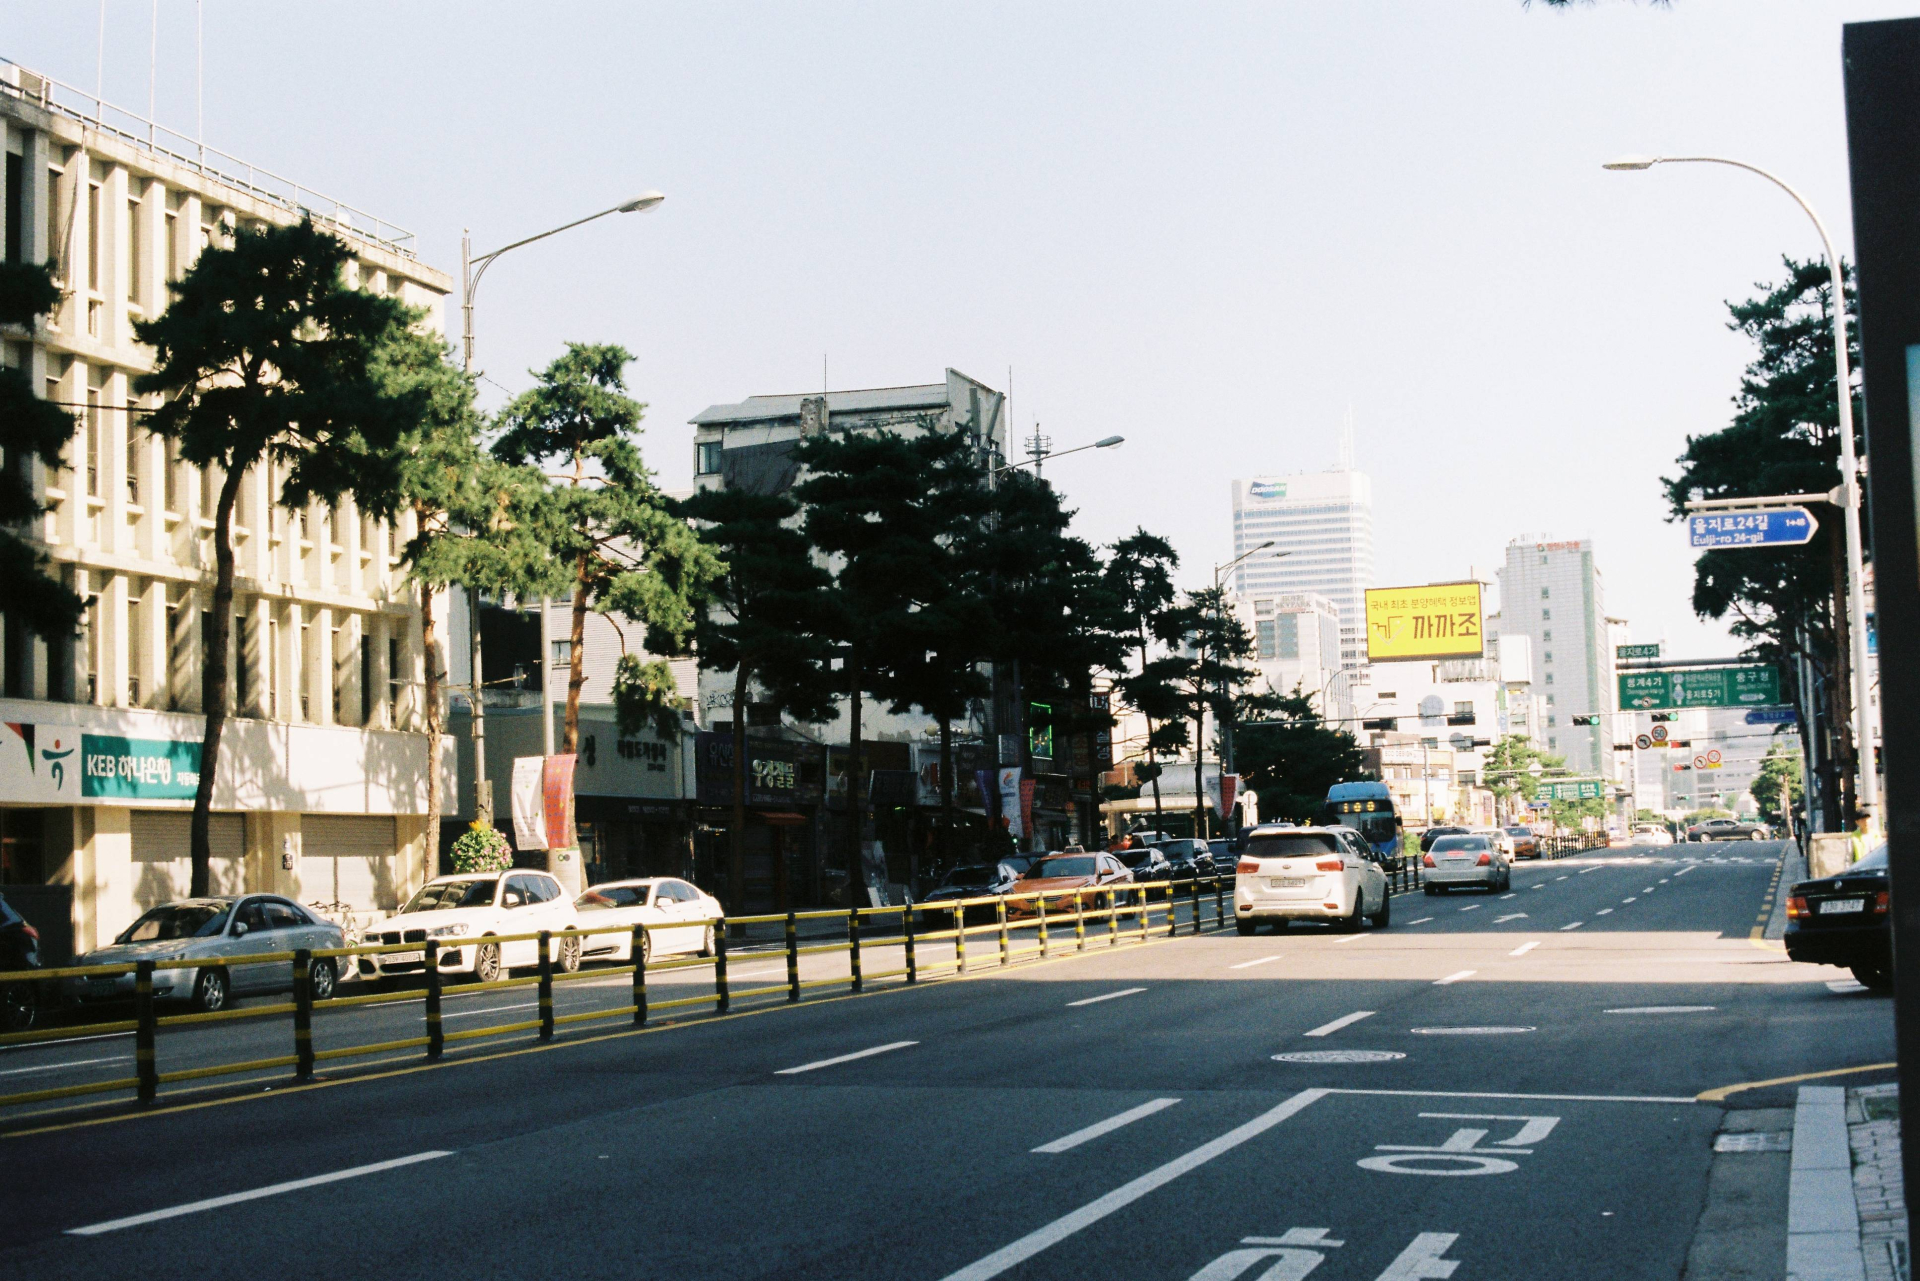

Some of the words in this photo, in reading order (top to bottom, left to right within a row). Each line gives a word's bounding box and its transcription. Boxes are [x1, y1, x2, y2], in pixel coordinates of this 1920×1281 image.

[1251, 486, 1286, 494] DOOSAN
[1693, 515, 1768, 535] 을지로24길
[1693, 535, 1732, 546] Eulji-ro
[1734, 532, 1764, 544] 24-gil
[1371, 600, 1389, 611] 국내
[1391, 598, 1408, 610] 최초
[1410, 596, 1447, 609] 분양혜택
[1449, 595, 1477, 607] 정보앱
[1412, 612, 1478, 640] 까까조
[1618, 646, 1657, 657] 을지로4가
[1686, 689, 1720, 700] 을지로5가
[1654, 729, 1664, 738] 50
[87, 754, 115, 777] KEB
[118, 755, 172, 785] 하나은행
[1343, 801, 1376, 813] 100
